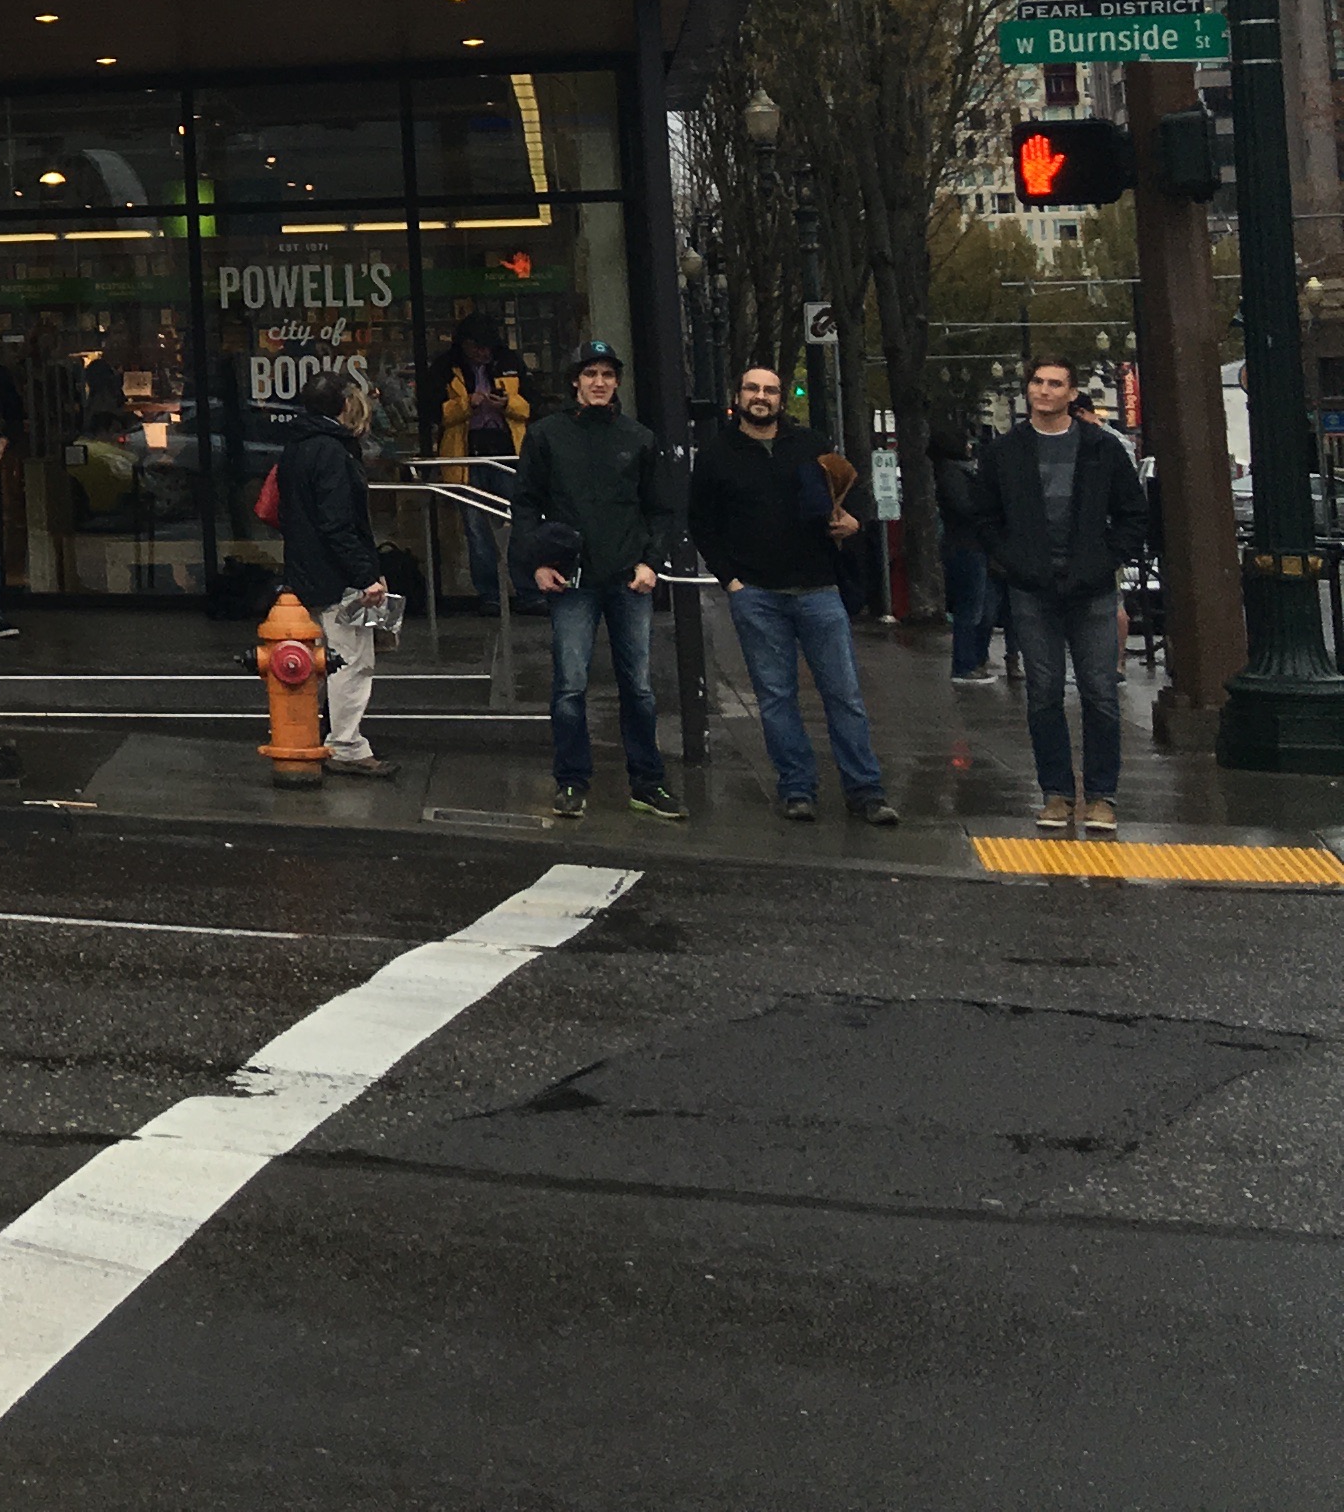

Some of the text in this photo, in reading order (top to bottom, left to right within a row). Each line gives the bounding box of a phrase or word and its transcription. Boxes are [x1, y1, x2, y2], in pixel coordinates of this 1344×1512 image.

[1021, 0, 1201, 19] PEARL DISTRICT
[1016, 24, 1211, 54] W Burnside St
[219, 262, 393, 309] POWELL'S
[267, 317, 348, 347] city of
